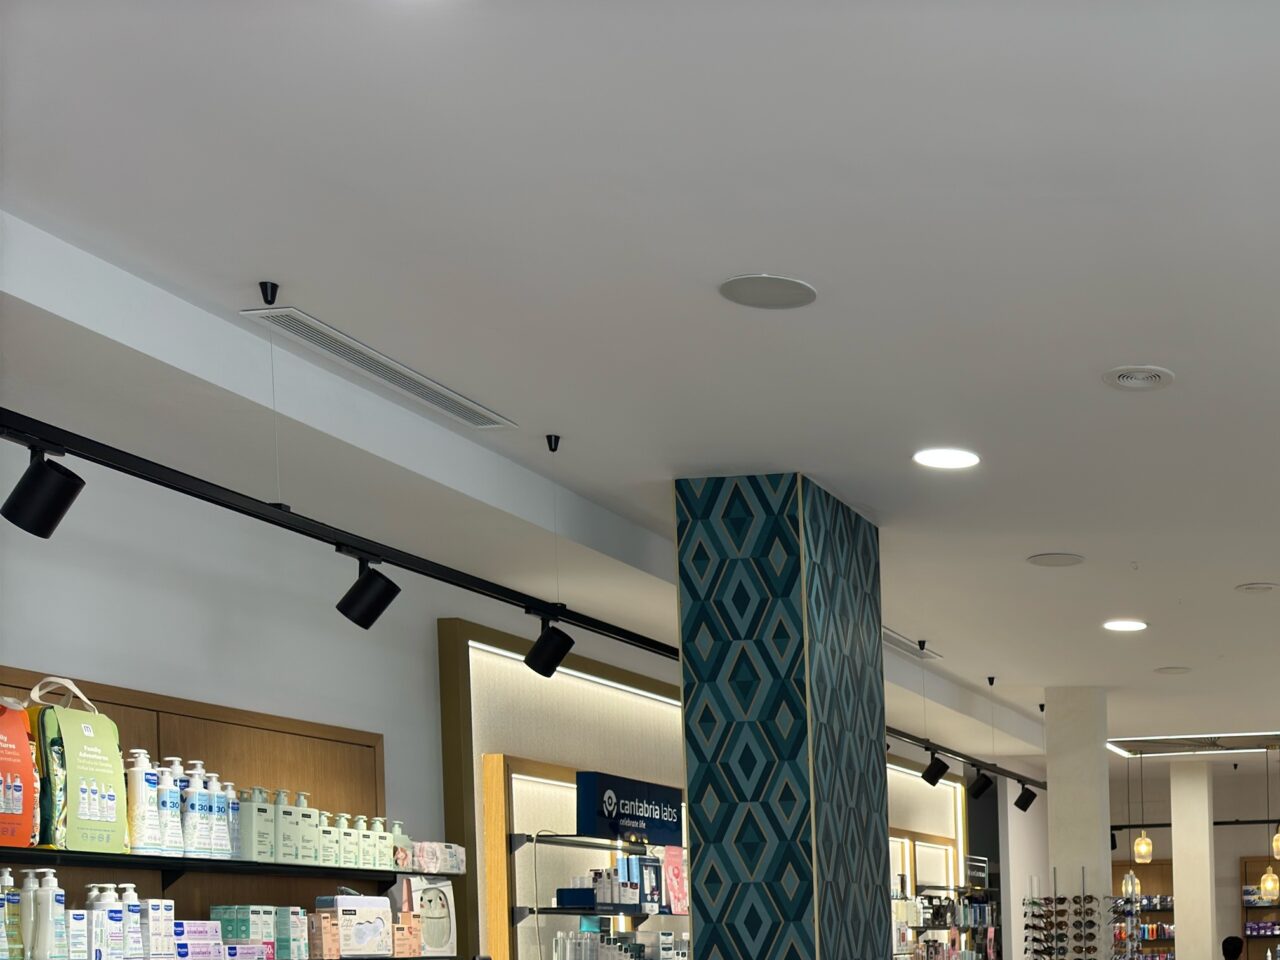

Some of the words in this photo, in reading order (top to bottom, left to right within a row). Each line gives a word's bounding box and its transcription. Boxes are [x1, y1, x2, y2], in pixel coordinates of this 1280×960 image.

[169, 801, 179, 809] 30
[198, 804, 208, 812] 30
[216, 806, 226, 814] 30
[620, 799, 660, 820] cantabria
[661, 803, 677, 822] labs
